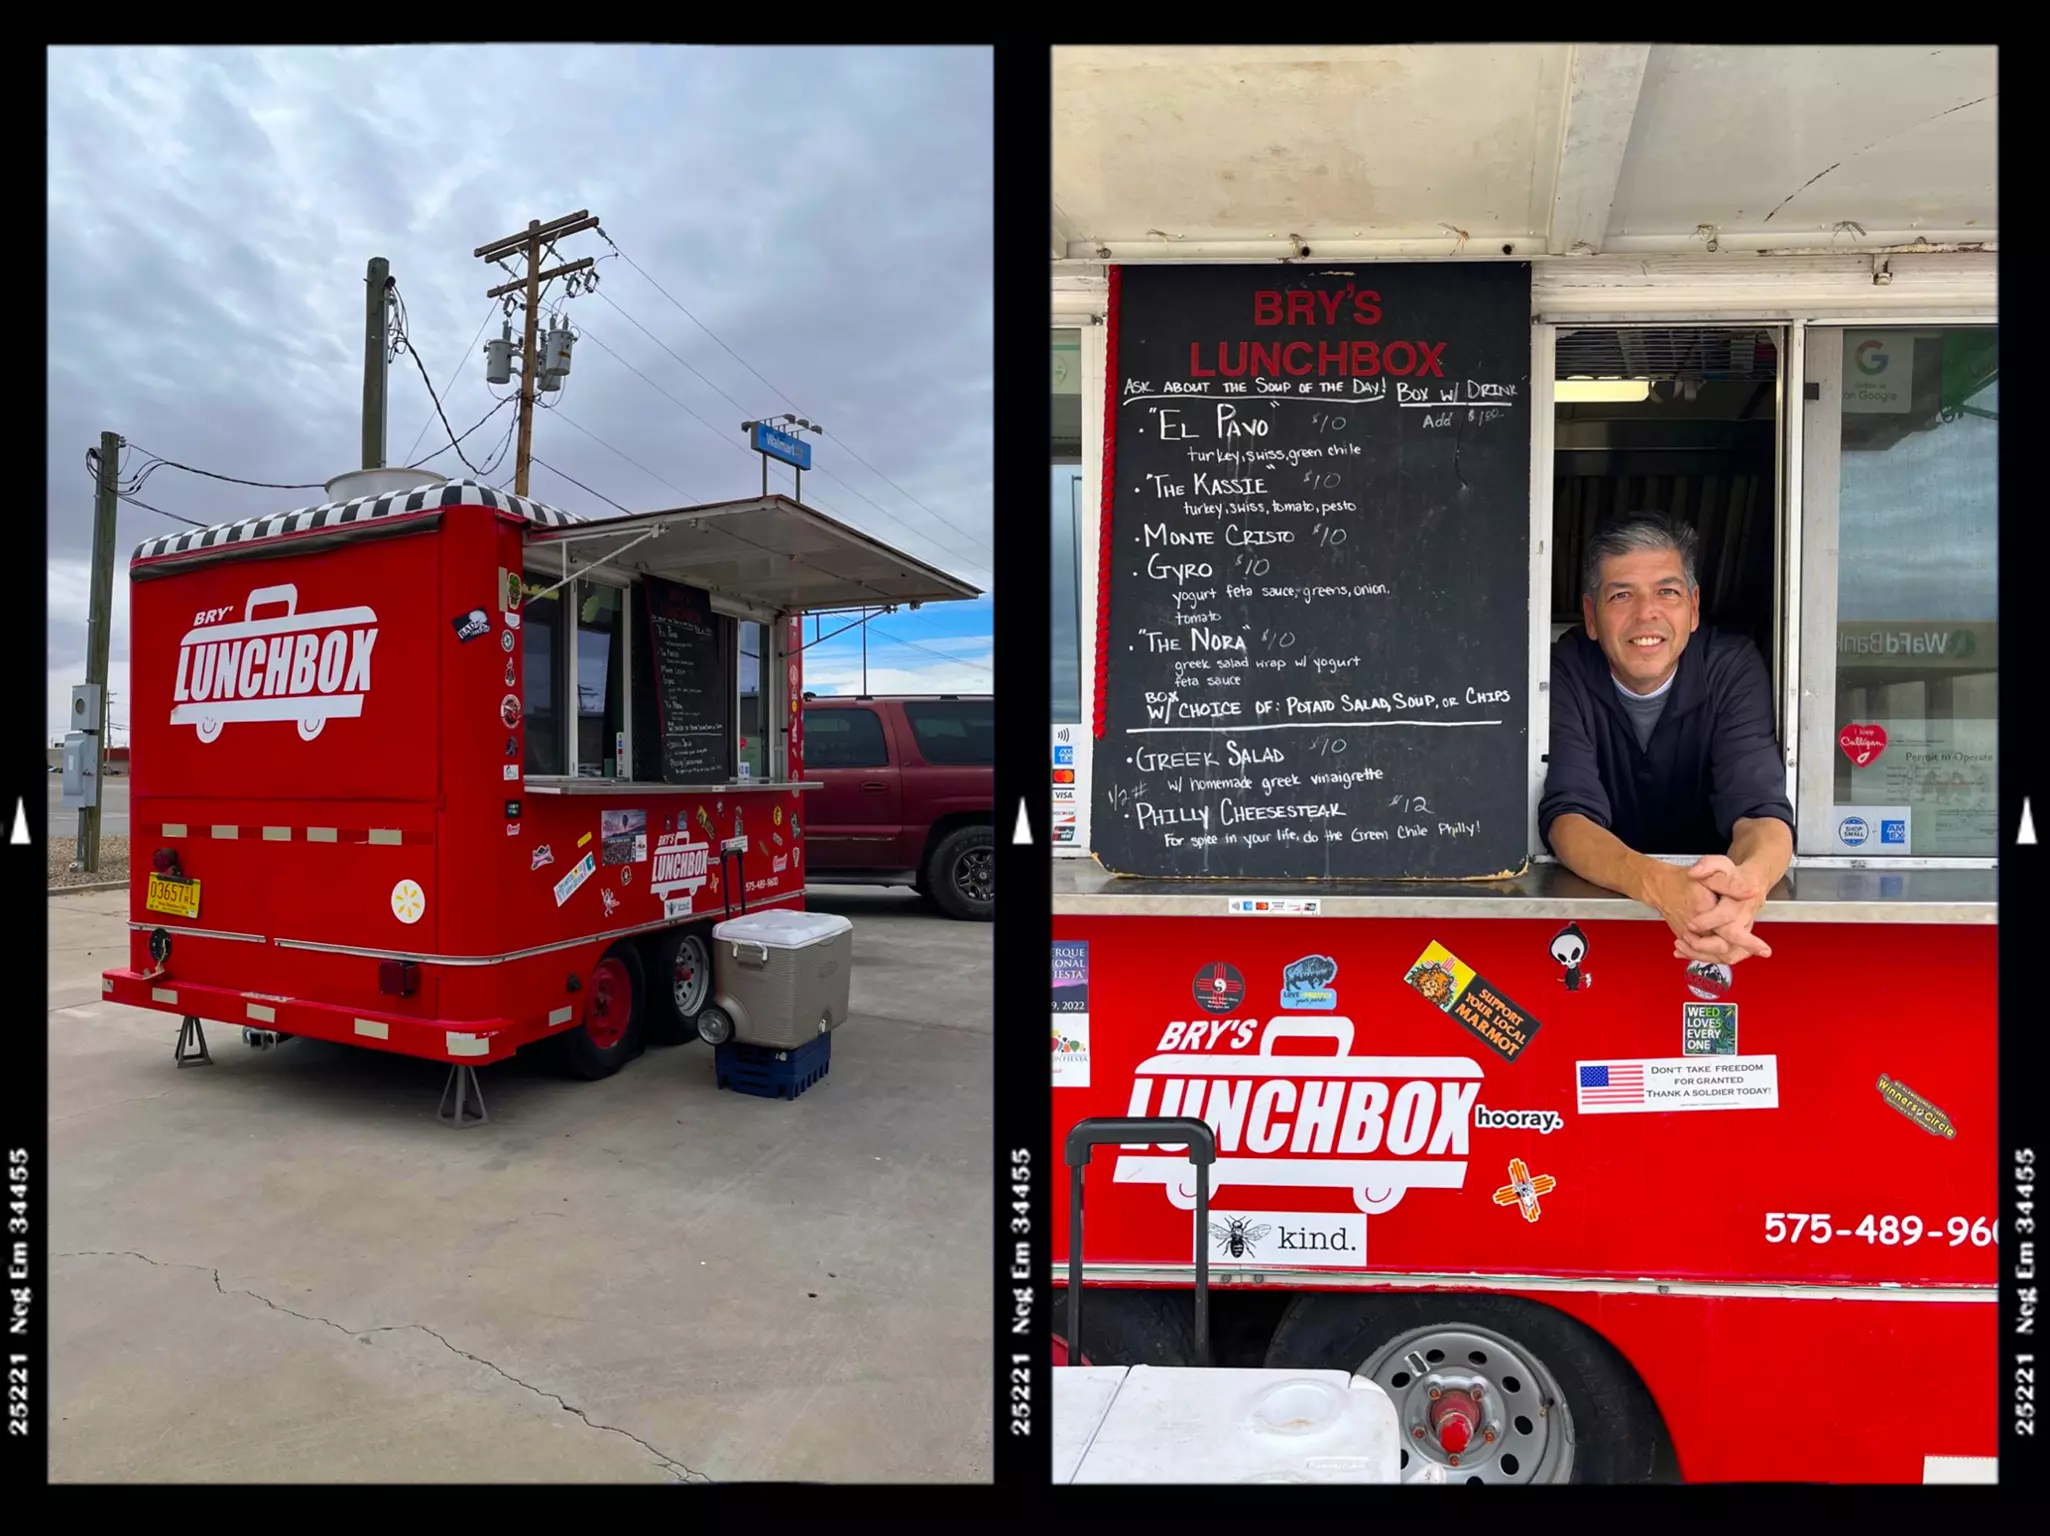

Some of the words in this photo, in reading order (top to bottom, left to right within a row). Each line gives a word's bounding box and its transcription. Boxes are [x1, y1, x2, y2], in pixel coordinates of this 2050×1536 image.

[1253, 284, 1382, 326] BRY'S
[1190, 341, 1448, 378] LUNCHBOX
[1124, 378, 1154, 395] ASK
[1164, 381, 1210, 394] ABOUT
[1222, 382, 1248, 393] THE
[1255, 377, 1291, 393] SOUP
[1299, 382, 1313, 393] OF
[1319, 382, 1344, 393] THE
[1353, 377, 1387, 395] DAY!
[1396, 382, 1429, 402] BOX
[1467, 379, 1518, 400] DRINK
[1858, 390, 1898, 403] Google
[1422, 411, 1453, 429] Add
[766, 433, 795, 456] Walmart
[1328, 441, 1361, 456] chile
[1303, 469, 1341, 490] $10
[1322, 501, 1357, 517] pesto
[1144, 522, 1215, 548] MONTE
[1225, 523, 1296, 547] CRISTO
[1312, 522, 1347, 547] $10
[1147, 552, 1214, 586] GYRO
[1235, 553, 1271, 577] $10
[1172, 588, 1217, 610] yogurt
[1226, 584, 1254, 598] feta
[192, 604, 234, 627] BRY'
[1174, 610, 1222, 626] tomato
[1261, 628, 1296, 650] $10
[173, 628, 379, 702] LUNCHBOX
[1174, 658, 1211, 677] greek
[1216, 656, 1249, 668] salad
[1255, 658, 1287, 671] wrap
[1313, 656, 1361, 673] yogurt
[1174, 674, 1200, 688] feta
[1207, 675, 1242, 686] sauce
[1144, 690, 1180, 703] BOX
[1178, 701, 1242, 718] CHOICE
[1286, 696, 1335, 716] POTATO
[1465, 687, 1511, 704] CHIPS
[1859, 728, 1874, 736] love
[1135, 746, 1220, 772] GREEK
[1226, 740, 1285, 767] SALAD
[1905, 752, 1937, 762] Permit
[1941, 752, 1951, 762] to
[1954, 752, 1993, 764] Operate
[1190, 775, 1253, 792] homemade
[1261, 774, 1301, 796] greek
[1310, 767, 1384, 789] vinaigrette
[1055, 791, 1073, 799] VISA
[1135, 802, 1209, 830] PHILLY
[1220, 797, 1347, 826] CHEESESTEAK
[1164, 834, 1184, 848] For
[1190, 834, 1218, 849] spice
[1226, 833, 1237, 844] in
[1243, 834, 1271, 849] your
[1303, 830, 1319, 843] do
[1324, 829, 1343, 841] the
[1350, 827, 1389, 842] Green
[1397, 824, 1428, 840] Chile
[1438, 820, 1481, 837] Philly!
[651, 850, 709, 882] LUNCHBOX
[1062, 1000, 1085, 1010] 2022
[1479, 988, 1524, 1026] SUPPORT
[1687, 1006, 1720, 1017] WEED
[1465, 992, 1493, 1019] YOUR
[1493, 1015, 1526, 1044] LOCAL
[1687, 1018, 1721, 1028] LOVES
[1156, 1018, 1259, 1051] BRY'S
[1454, 1003, 1520, 1057] MARMOT
[1687, 1028, 1721, 1039] EVERY
[1687, 1039, 1711, 1050] ONE
[1651, 1065, 1682, 1075] DON'T
[1687, 1065, 1711, 1073] TAKE
[1715, 1064, 1764, 1073] FREEDOM
[1674, 1077, 1694, 1085] FOR
[1696, 1076, 1744, 1085] GRANTED
[1646, 1088, 1683, 1098] THANK
[1683, 1089, 1691, 1097] A
[1692, 1087, 1735, 1097] SOLDIER
[1736, 1087, 1771, 1096] TODAY!
[1120, 1078, 1481, 1155] LUNCHBOX
[1879, 1078, 1918, 1111] Winners
[1924, 1112, 1954, 1136] Circle
[1478, 1108, 1562, 1131] hooray.
[1277, 1226, 1357, 1251] kind.
